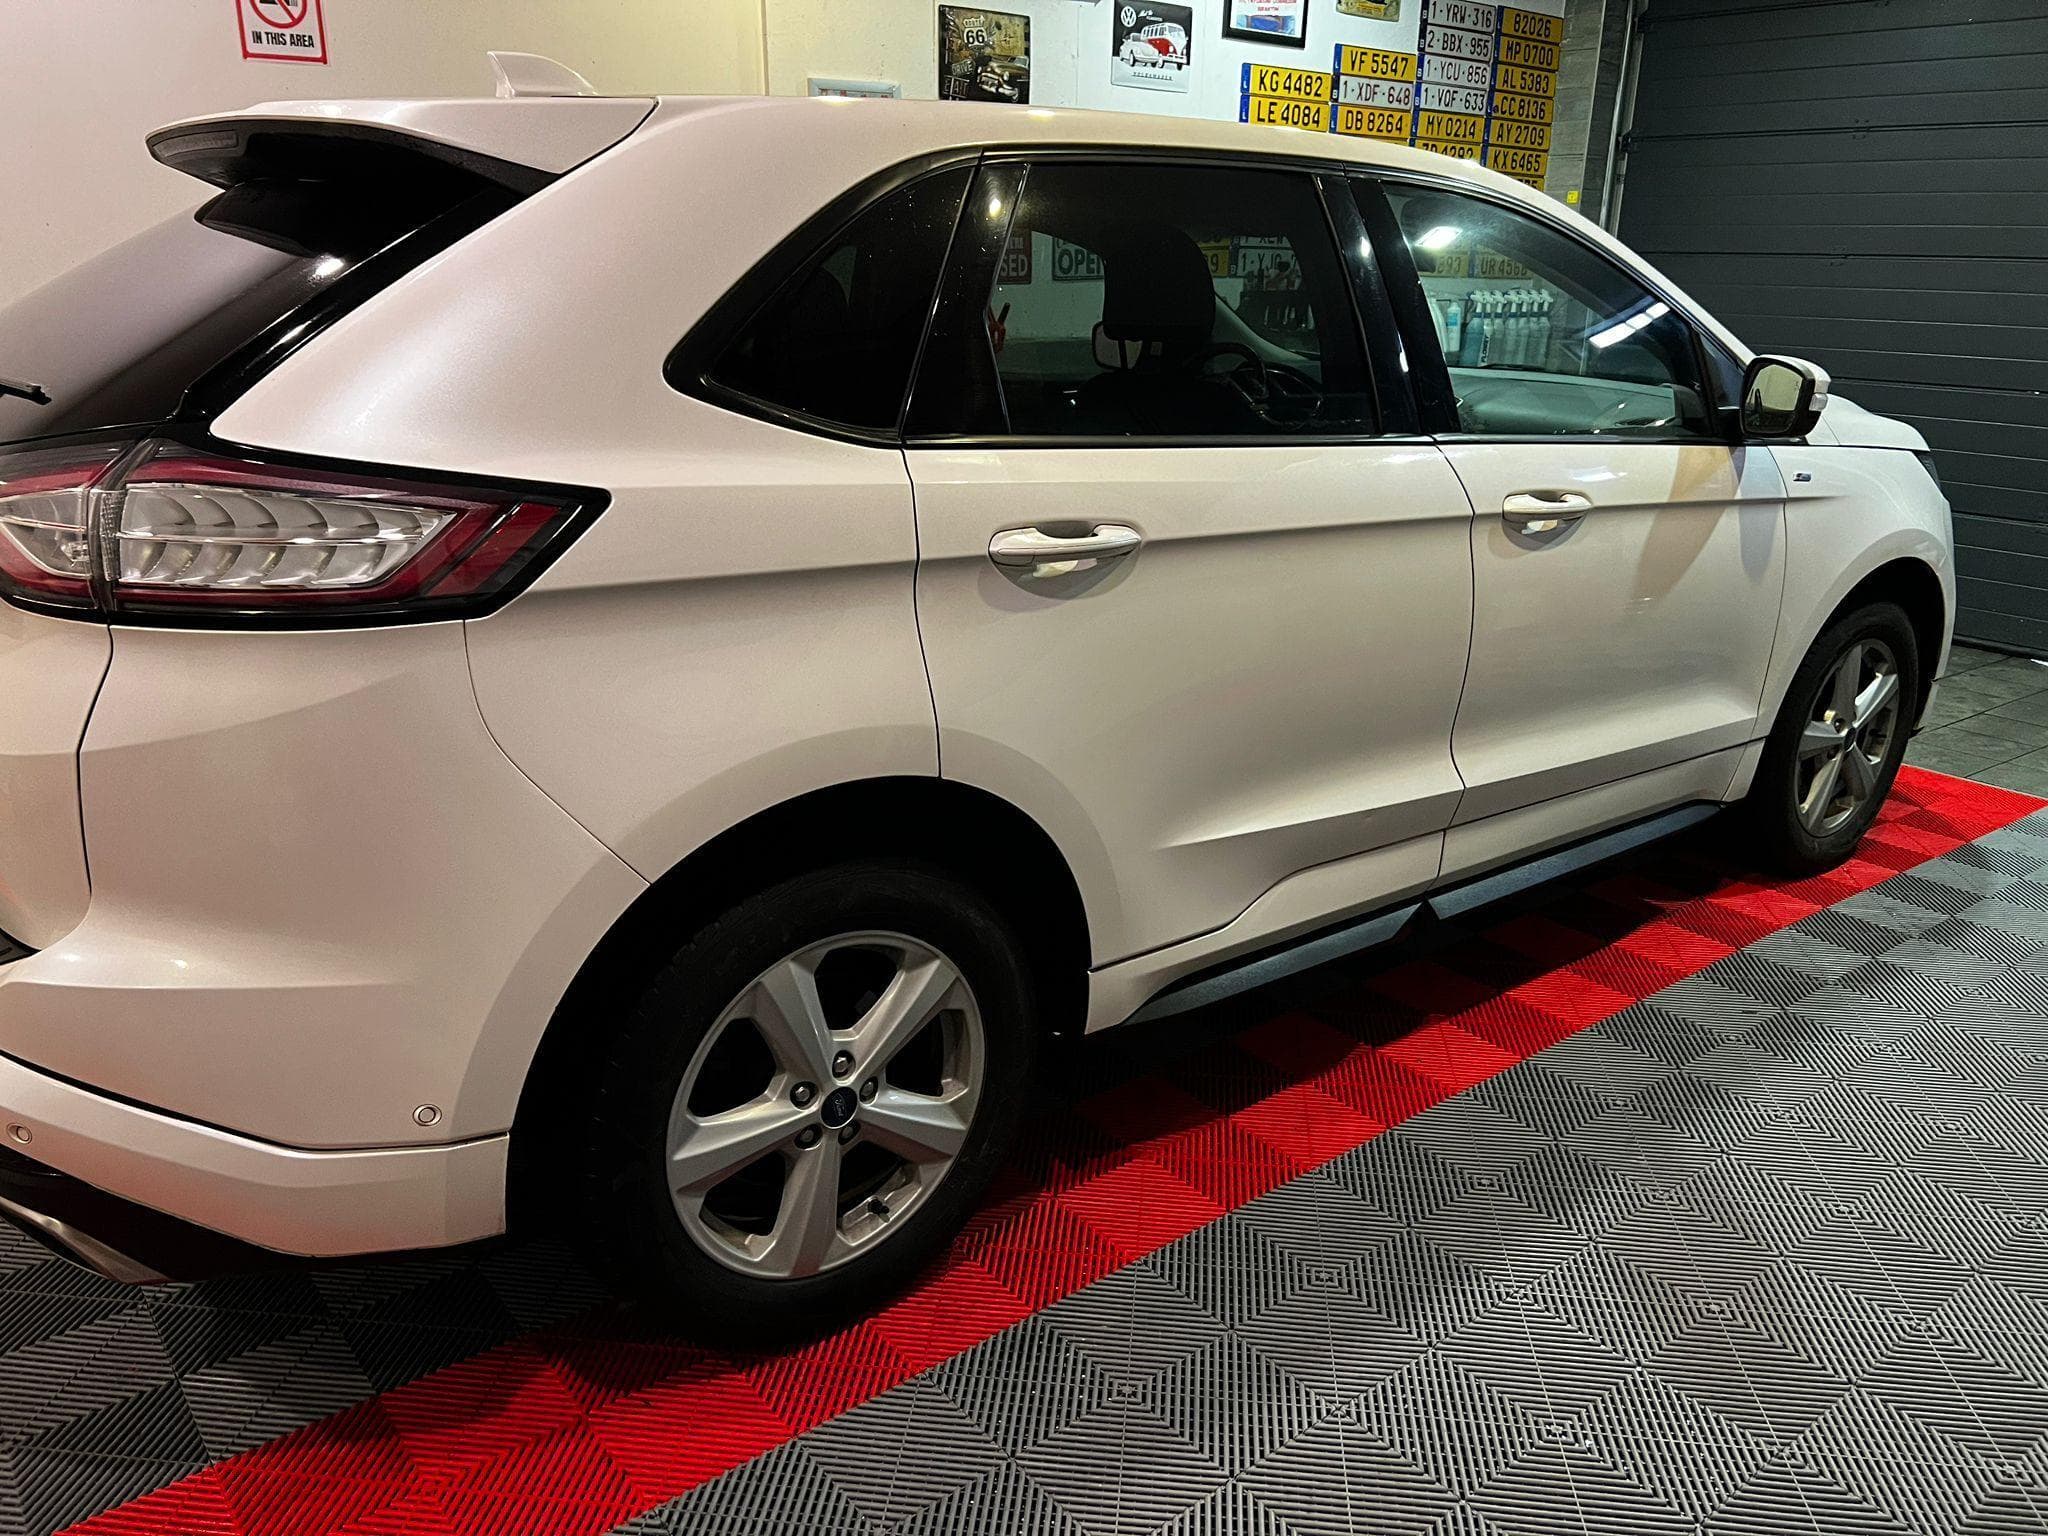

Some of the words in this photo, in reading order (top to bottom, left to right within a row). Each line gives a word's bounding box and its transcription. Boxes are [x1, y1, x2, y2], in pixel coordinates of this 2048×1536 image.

[252, 31, 262, 44] IN
[264, 32, 287, 45] THIS
[289, 34, 314, 48] AREA
[966, 29, 985, 44] 66
[1351, 50, 1368, 72] VF
[1371, 53, 1408, 77] 5547
[1524, 44, 1553, 66] 0700
[1259, 69, 1279, 92] KG
[1283, 72, 1323, 97] 4482
[1502, 68, 1516, 88] AL
[1520, 71, 1549, 93] 5383
[1257, 100, 1278, 123] LE
[1281, 103, 1320, 128] 4084
[1518, 99, 1546, 120] 8136
[1345, 110, 1363, 131] DB
[1367, 112, 1403, 134] 8264
[1445, 117, 1476, 139] 0214
[1496, 123, 1513, 143] AY
[1514, 125, 1545, 146] 2709
[1493, 149, 1509, 169] KX
[1510, 151, 1542, 172] 6465
